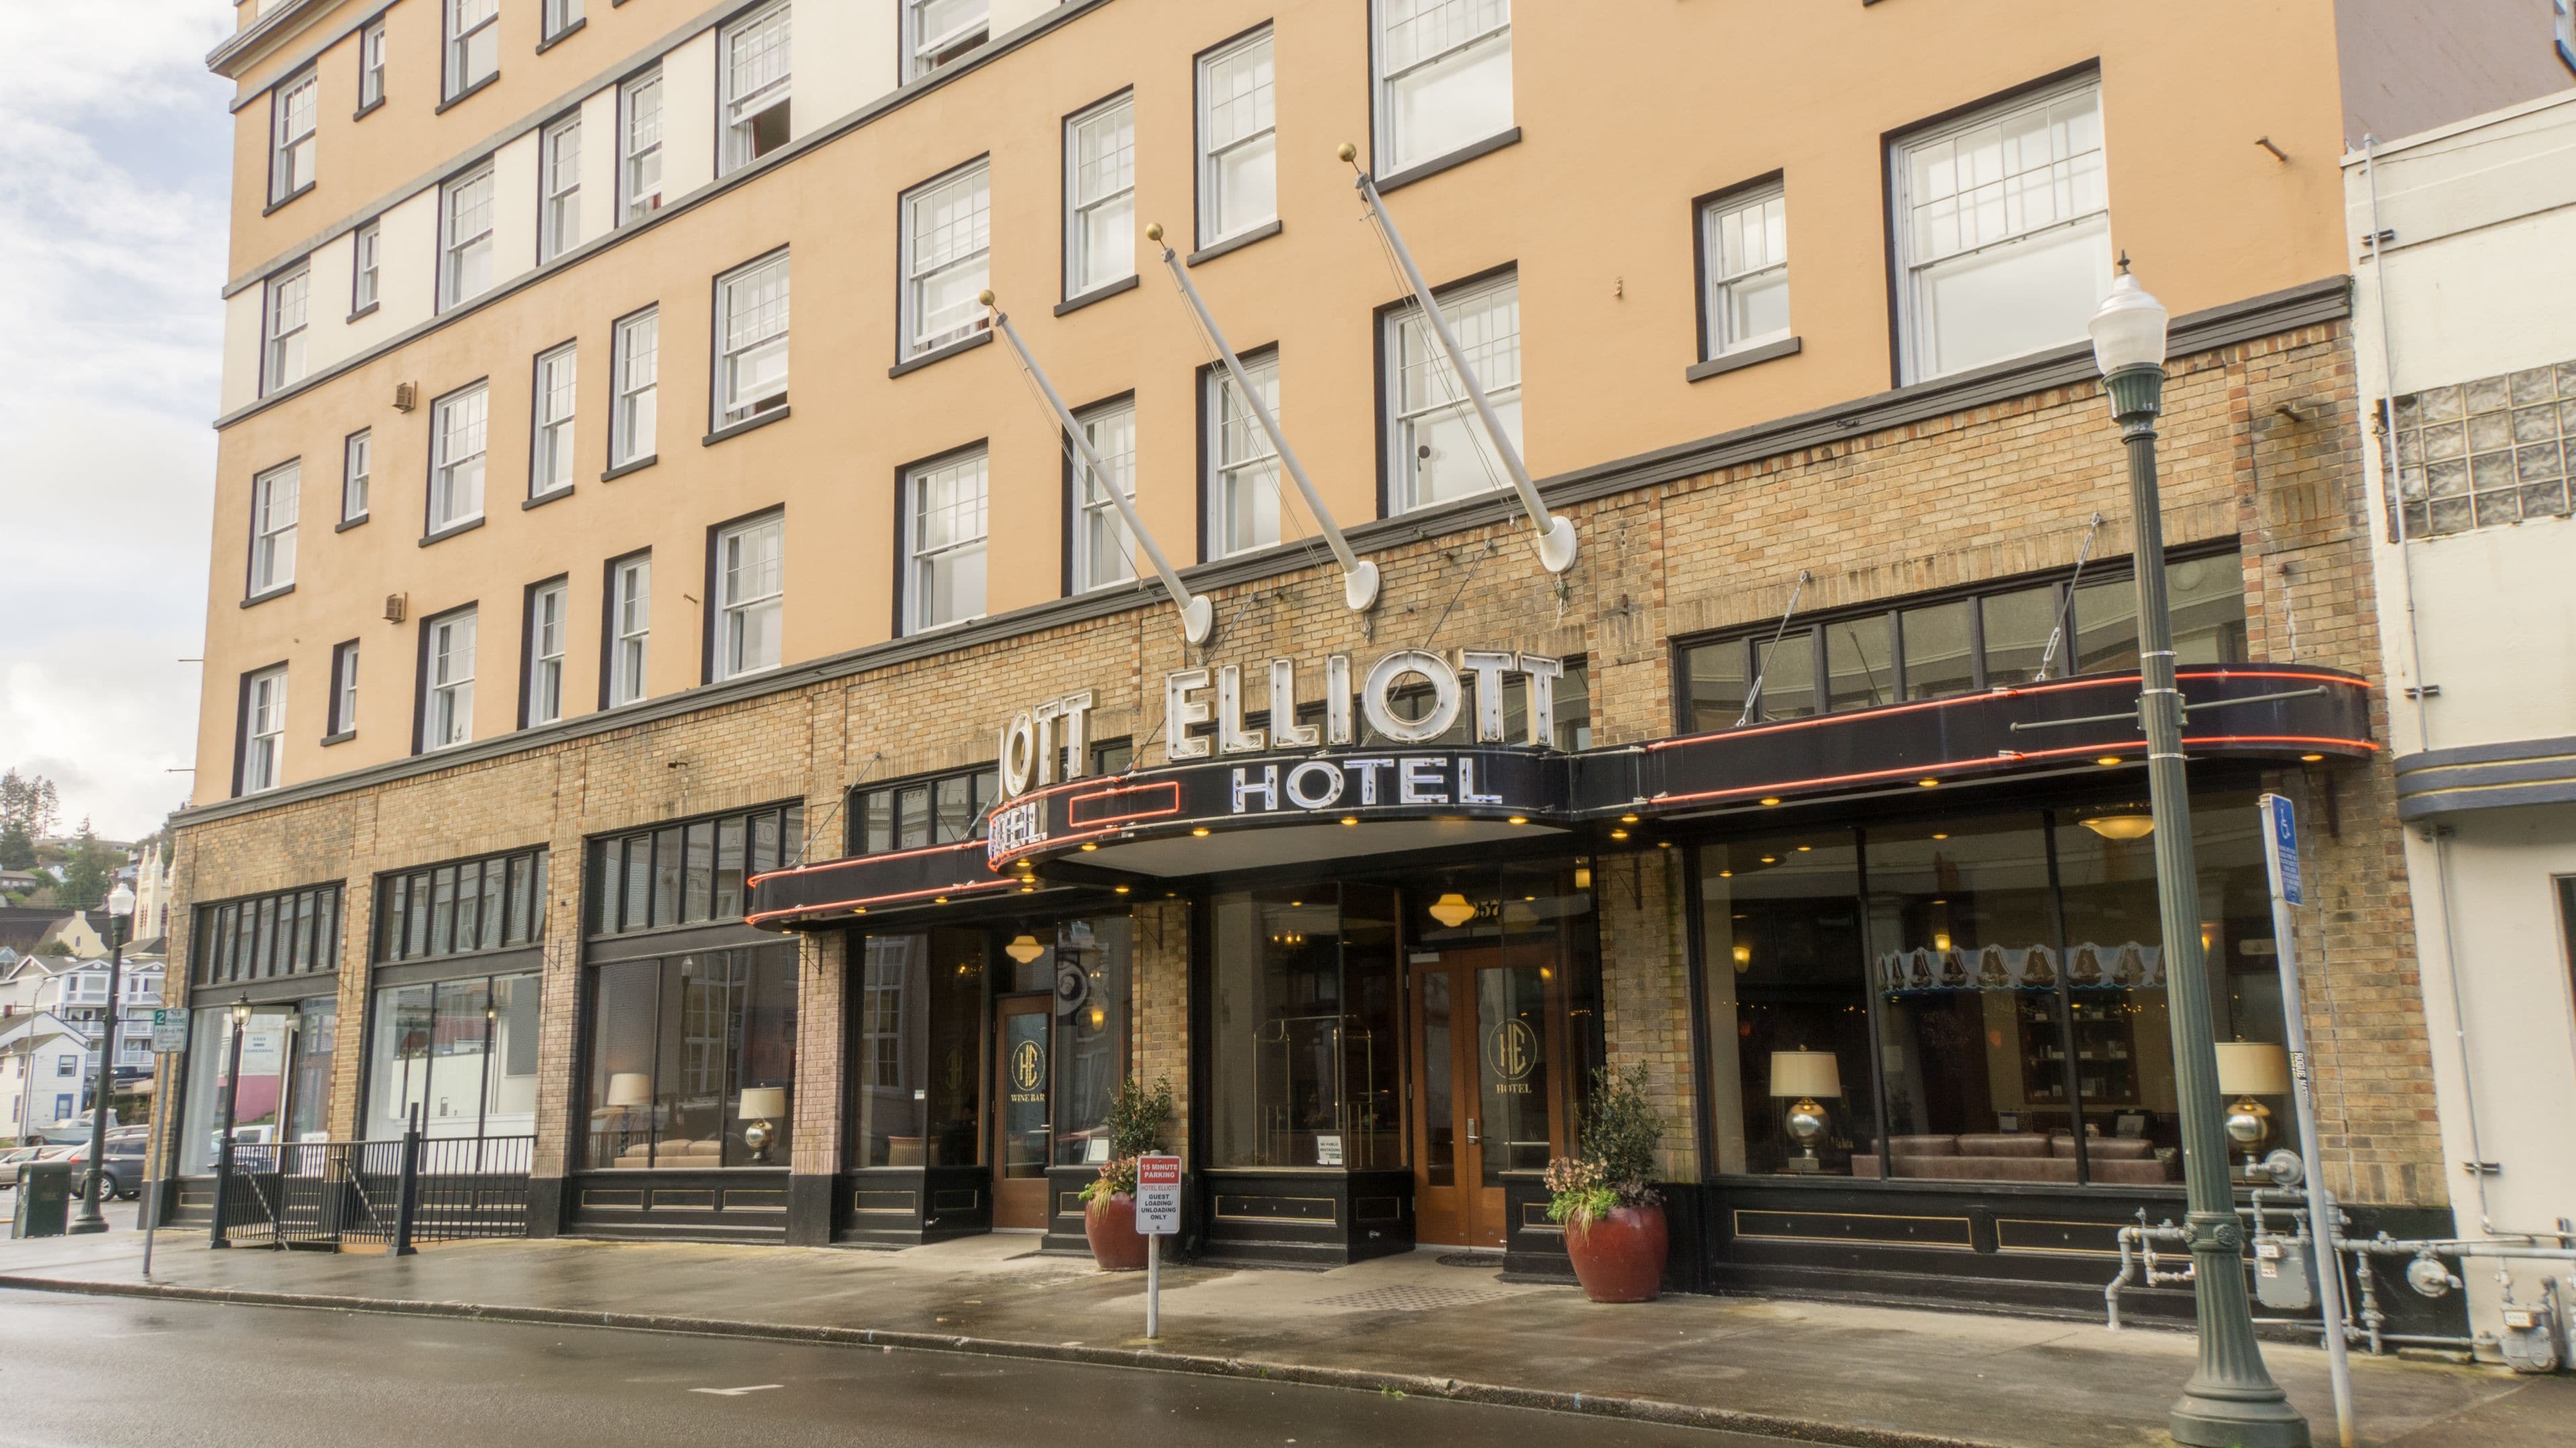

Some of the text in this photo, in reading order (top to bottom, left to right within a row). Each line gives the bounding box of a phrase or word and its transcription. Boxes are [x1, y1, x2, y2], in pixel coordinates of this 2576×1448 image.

[1166, 648, 1564, 761] ELLIOTT
[1232, 757, 1503, 813] HOTEL
[157, 1012, 165, 1023] 2
[1496, 1083, 1532, 1094] HOTEL
[1011, 1093, 1045, 1102] WINE BAR
